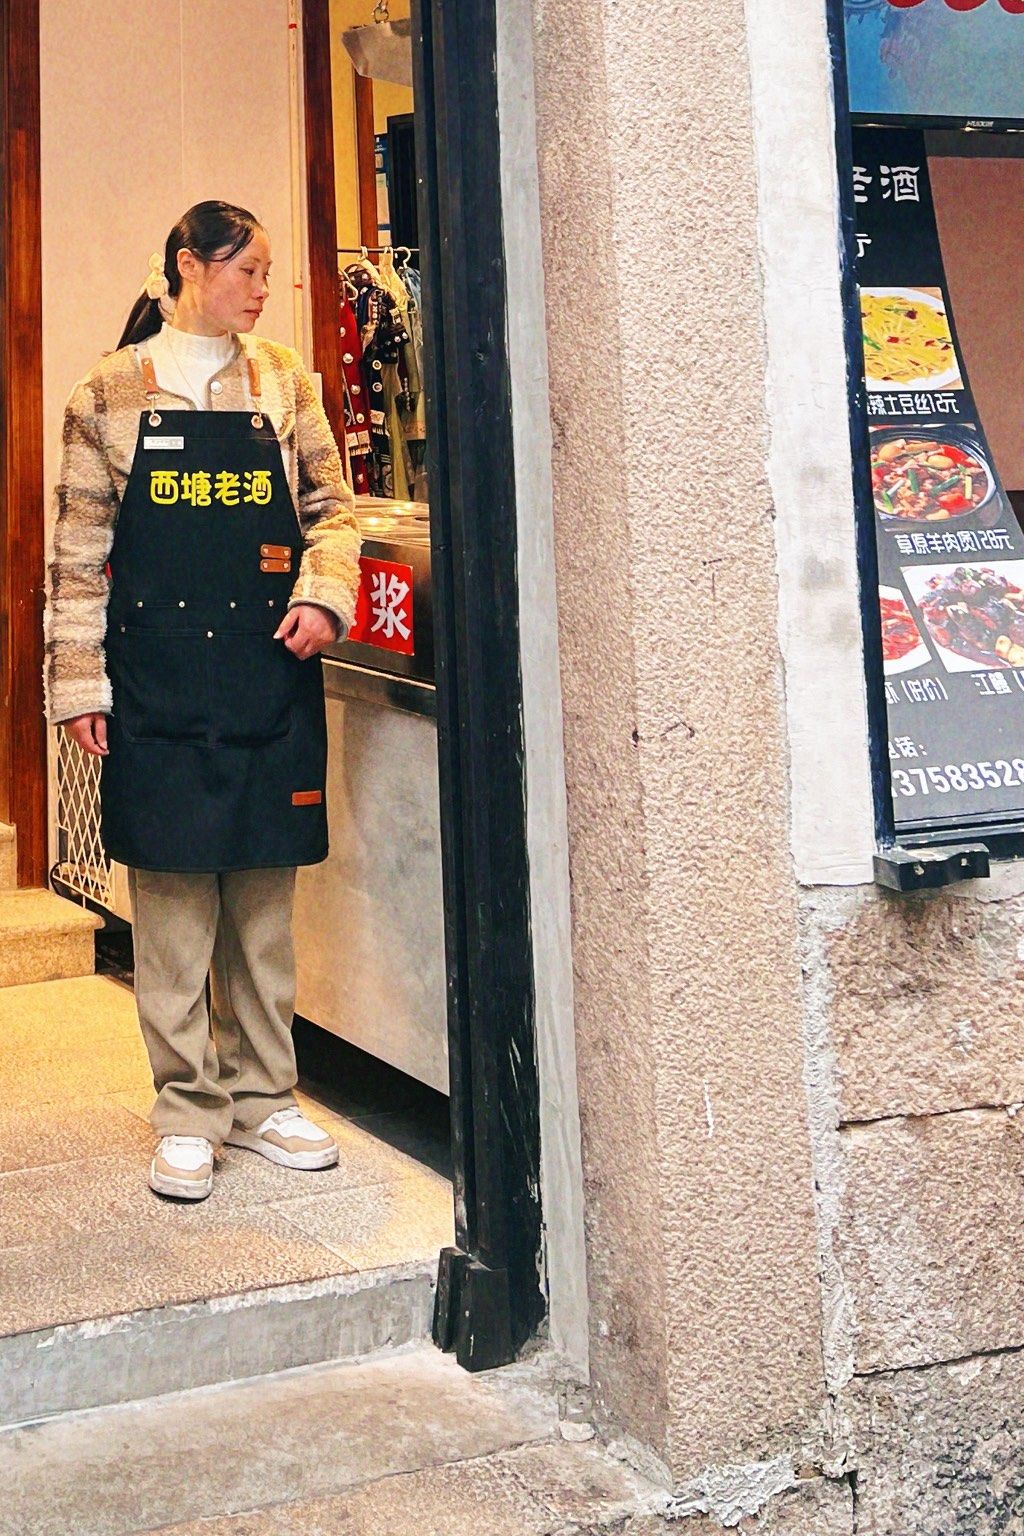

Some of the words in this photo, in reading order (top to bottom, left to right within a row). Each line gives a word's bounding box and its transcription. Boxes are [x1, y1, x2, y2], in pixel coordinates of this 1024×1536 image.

[867, 392, 960, 415] 辣土豆丝12元
[150, 470, 272, 507] 西塘老酒
[894, 528, 1015, 555] 草原羊肉煲128元
[370, 571, 411, 641] 浆
